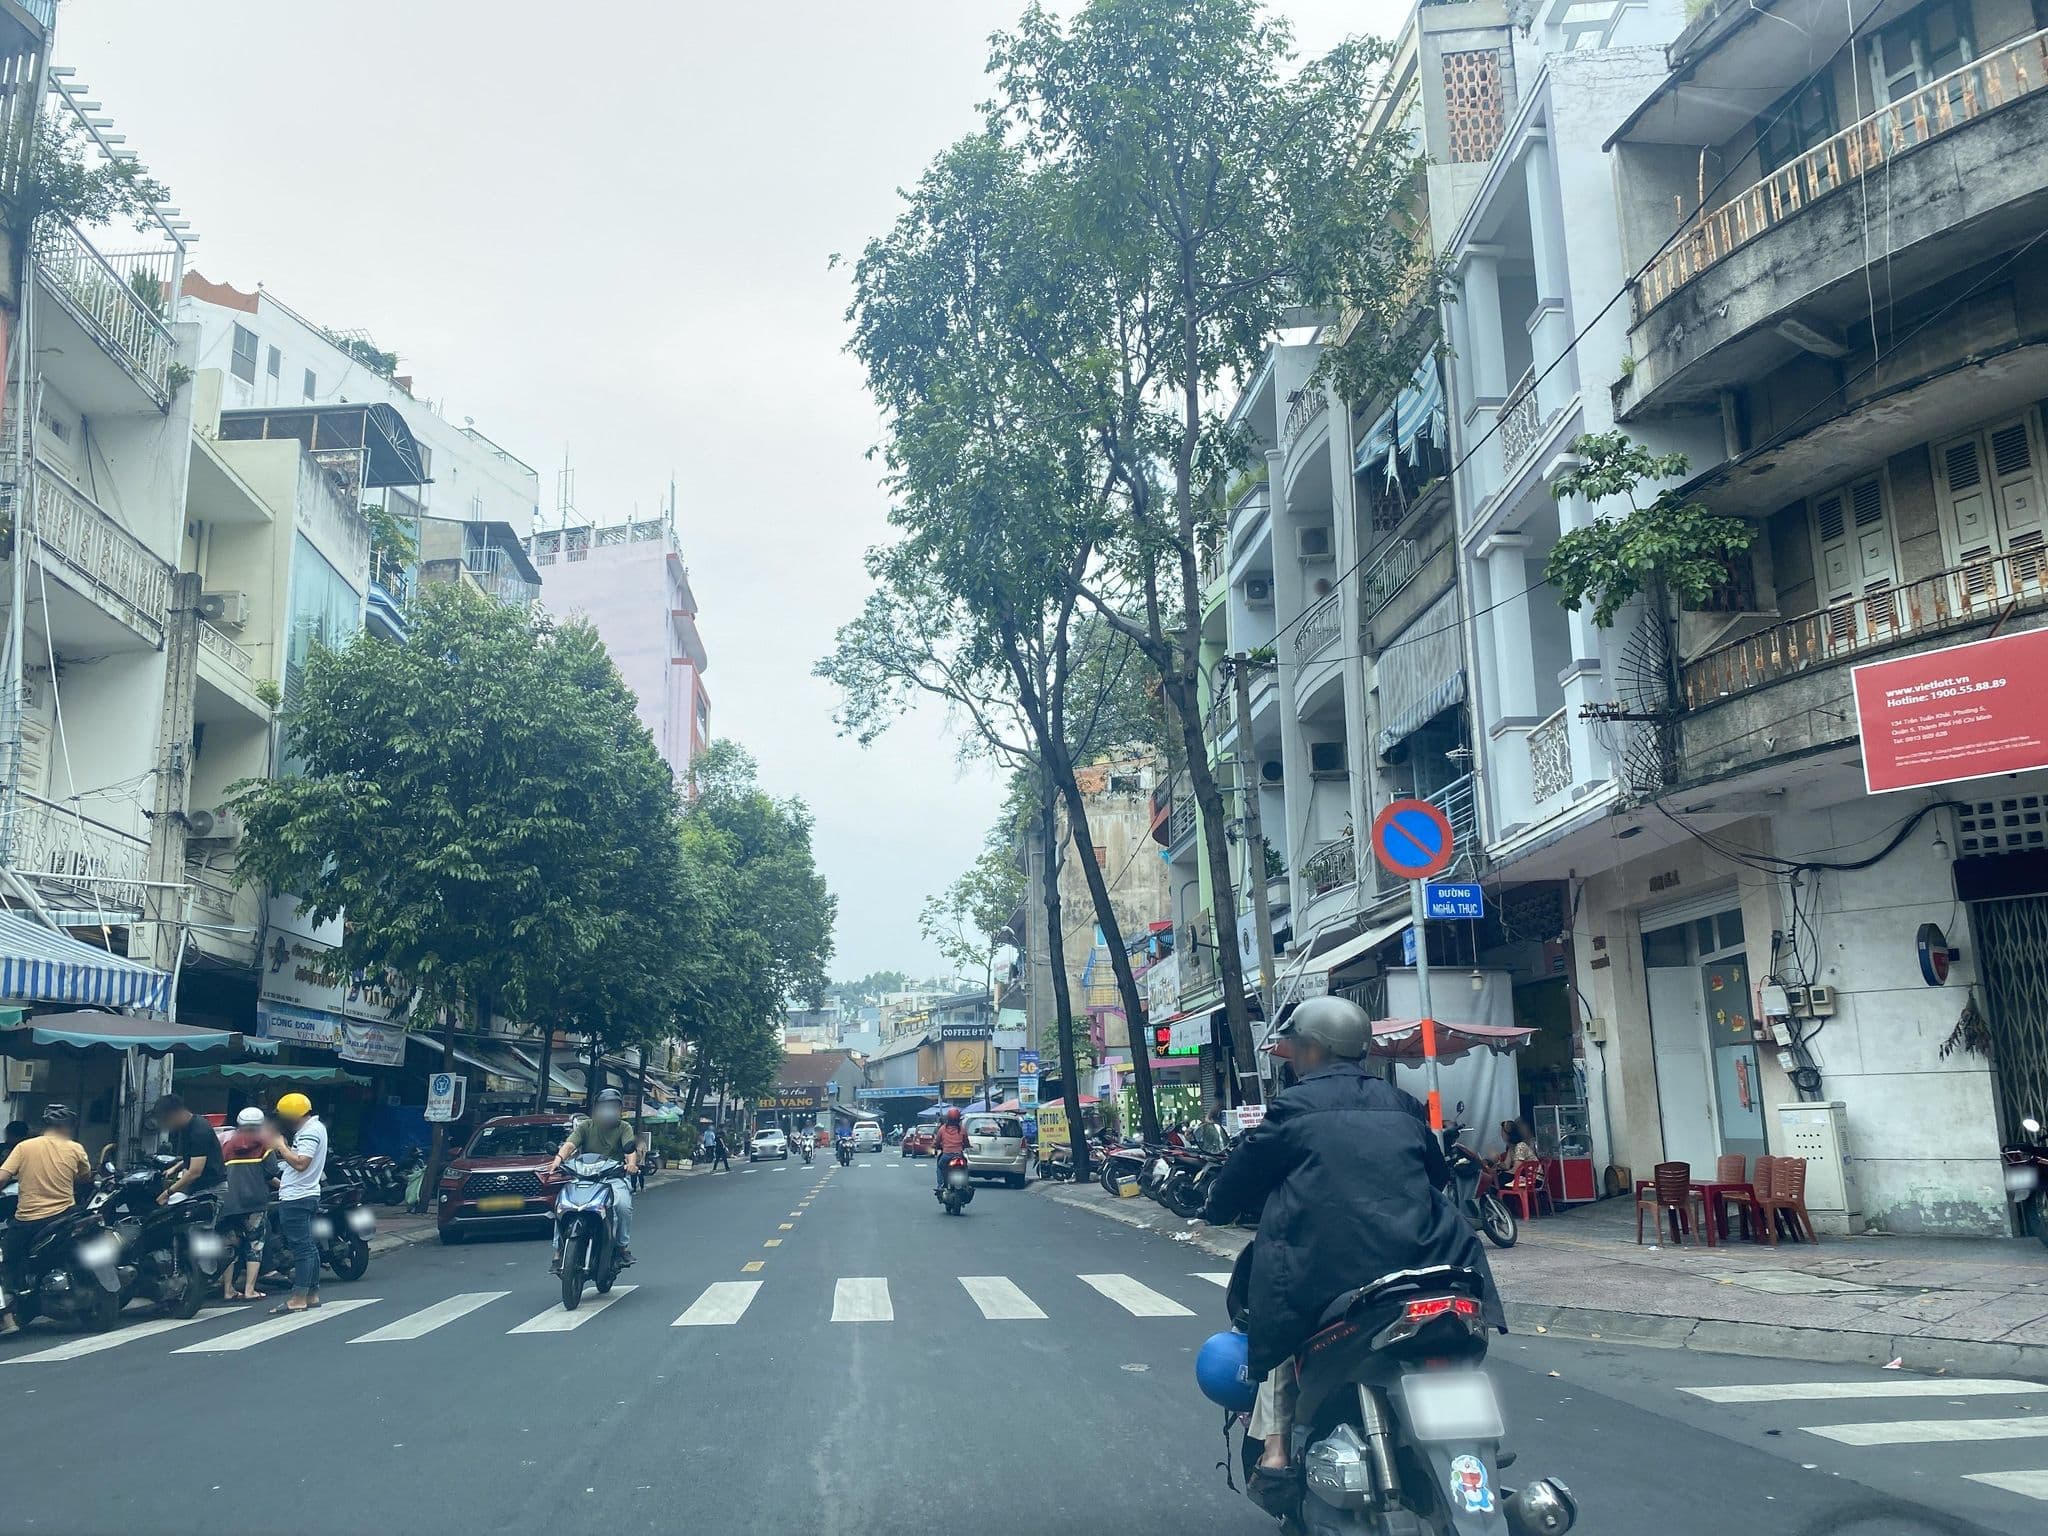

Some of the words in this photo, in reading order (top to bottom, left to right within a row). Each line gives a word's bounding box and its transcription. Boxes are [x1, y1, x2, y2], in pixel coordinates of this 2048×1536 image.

[1885, 676, 1970, 697] www.vietlott.vn
[1887, 694, 1929, 708] Hotline:
[1931, 678, 2007, 700] 1900.55.88.89
[1438, 888, 1471, 898] ĐƯỜNG
[1432, 901, 1456, 914] NGHĨA
[1457, 903, 1478, 915] THỤC
[943, 1028, 971, 1037] COFFEE
[780, 1097, 813, 1108] VANG
